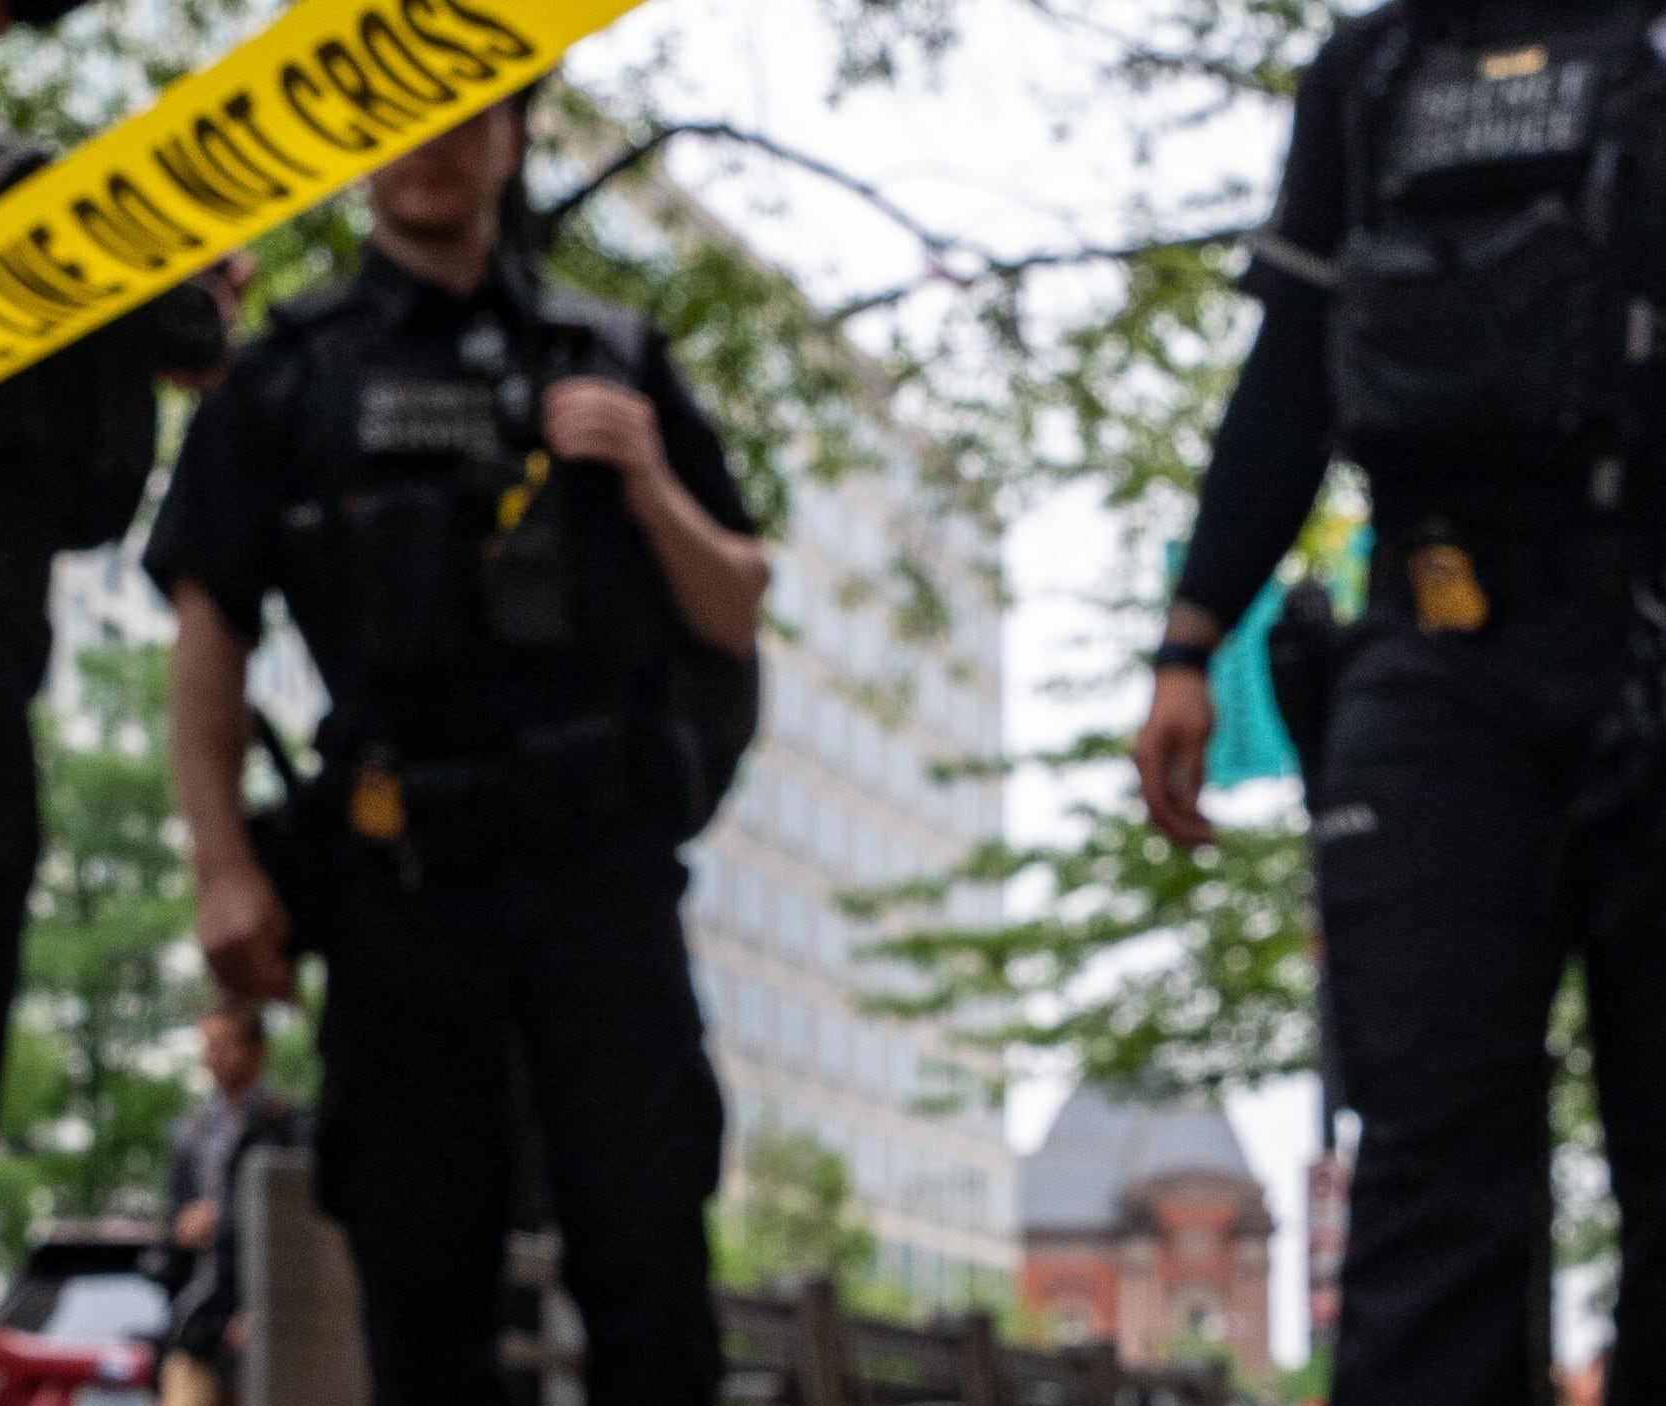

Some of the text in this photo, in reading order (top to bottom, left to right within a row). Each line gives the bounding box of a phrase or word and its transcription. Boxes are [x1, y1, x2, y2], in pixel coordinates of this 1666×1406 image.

[69, 172, 206, 270] DO
[150, 91, 323, 221] NOT
[278, 0, 535, 153] CROSS
